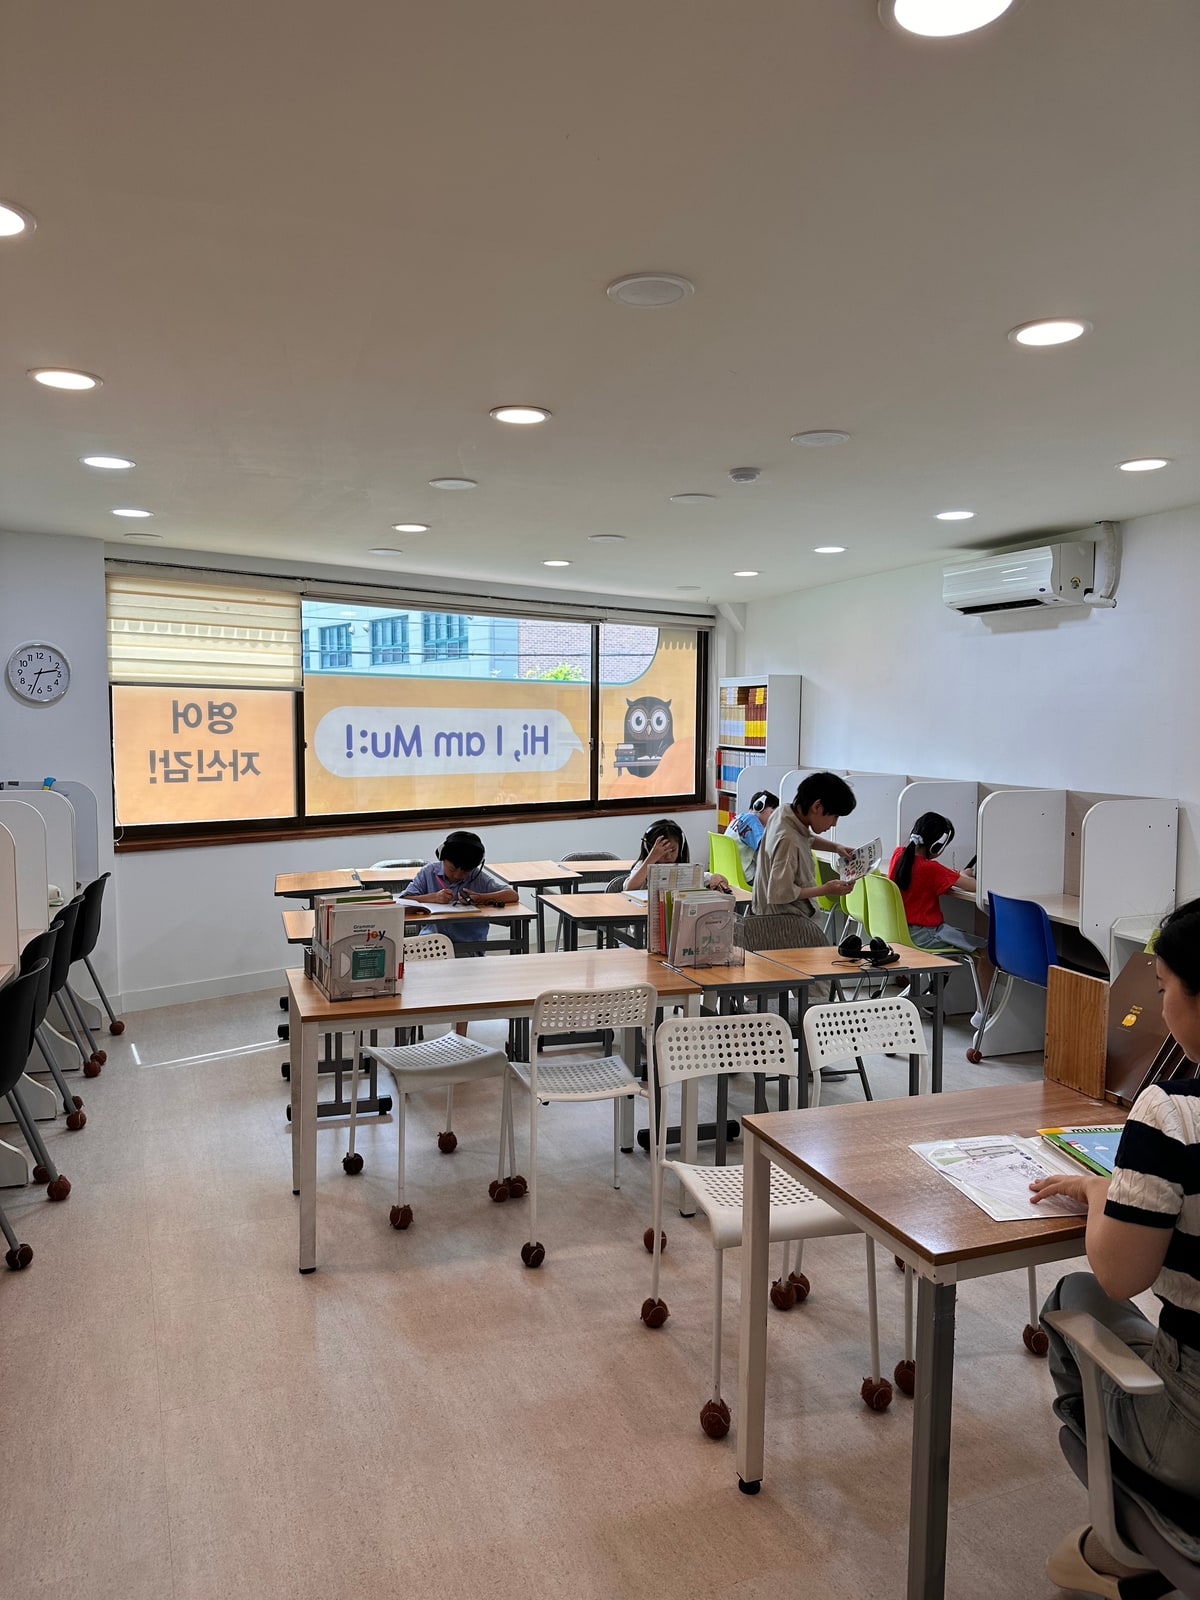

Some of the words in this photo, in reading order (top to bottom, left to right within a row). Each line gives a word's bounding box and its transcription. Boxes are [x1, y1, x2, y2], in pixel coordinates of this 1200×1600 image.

[27, 654, 33, 662] 11
[36, 652, 44, 660] 12
[20, 677, 26, 685] 8
[366, 929, 386, 942] joy
